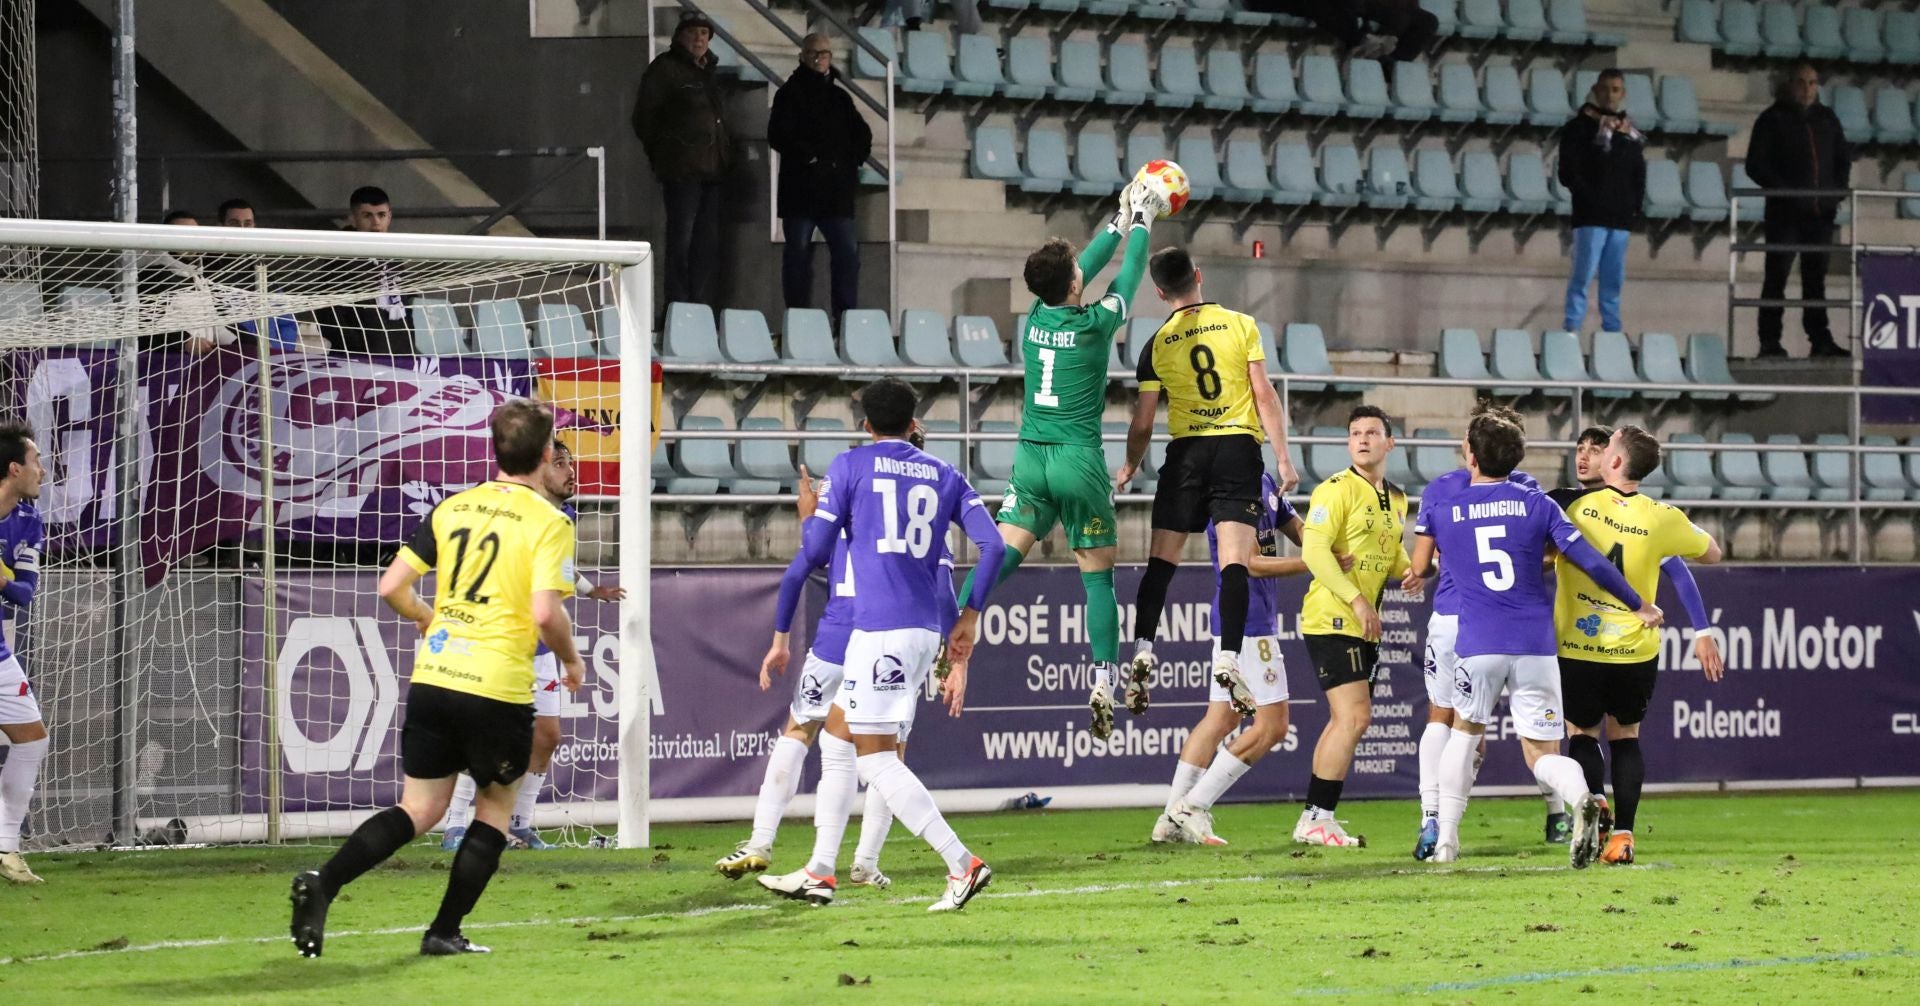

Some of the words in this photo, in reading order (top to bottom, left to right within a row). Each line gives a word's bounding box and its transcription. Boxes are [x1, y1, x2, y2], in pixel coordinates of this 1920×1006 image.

[1028, 326, 1050, 346] ALEX
[1053, 331, 1076, 348] FDEZ
[1165, 334, 1182, 345] CD.
[1185, 322, 1228, 338] Mojados
[1034, 347, 1059, 407] 1
[1190, 344, 1222, 401] 8
[874, 456, 939, 482] ANDERSON
[476, 504, 523, 522] Mojados
[873, 478, 939, 558] 18
[1452, 506, 1465, 523] D.
[1469, 500, 1527, 520] MUNGUIA
[1583, 507, 1601, 521] CD.
[1604, 516, 1649, 537] Mojados
[449, 527, 501, 605] 12
[1474, 524, 1515, 592] 5
[1257, 638, 1272, 663] 8
[1583, 643, 1594, 652] de
[1597, 645, 1635, 657] Mojados
[1761, 608, 1883, 670] Motor
[1347, 646, 1363, 673] 11
[437, 665, 483, 683] Mojados
[1673, 698, 1781, 738] Palencia
[1355, 742, 1417, 756] ELECTRICIDAD
[1355, 760, 1396, 773] PARQUET
